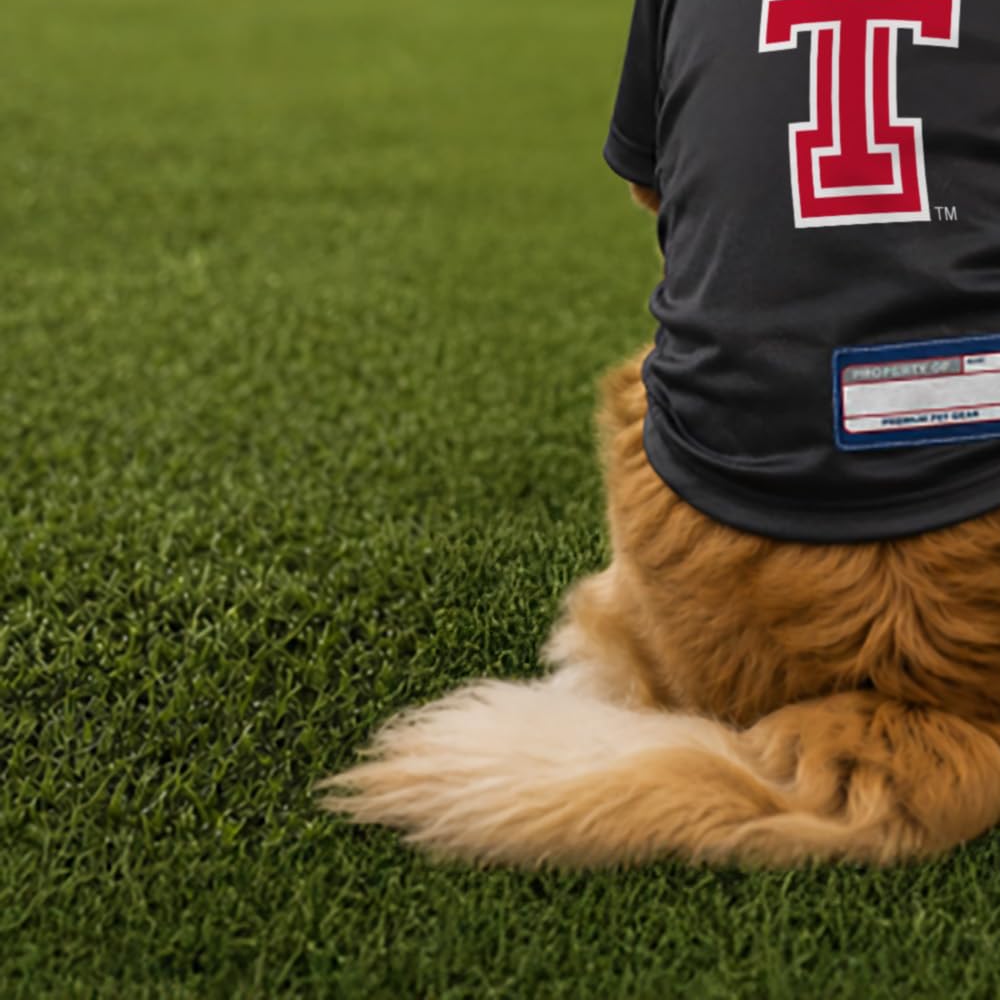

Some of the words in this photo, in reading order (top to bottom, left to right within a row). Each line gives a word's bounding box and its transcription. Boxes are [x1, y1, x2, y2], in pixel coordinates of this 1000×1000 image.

[933, 205, 958, 222] TM
[851, 362, 928, 380] PROPERTY
[951, 409, 979, 420] GEAR
